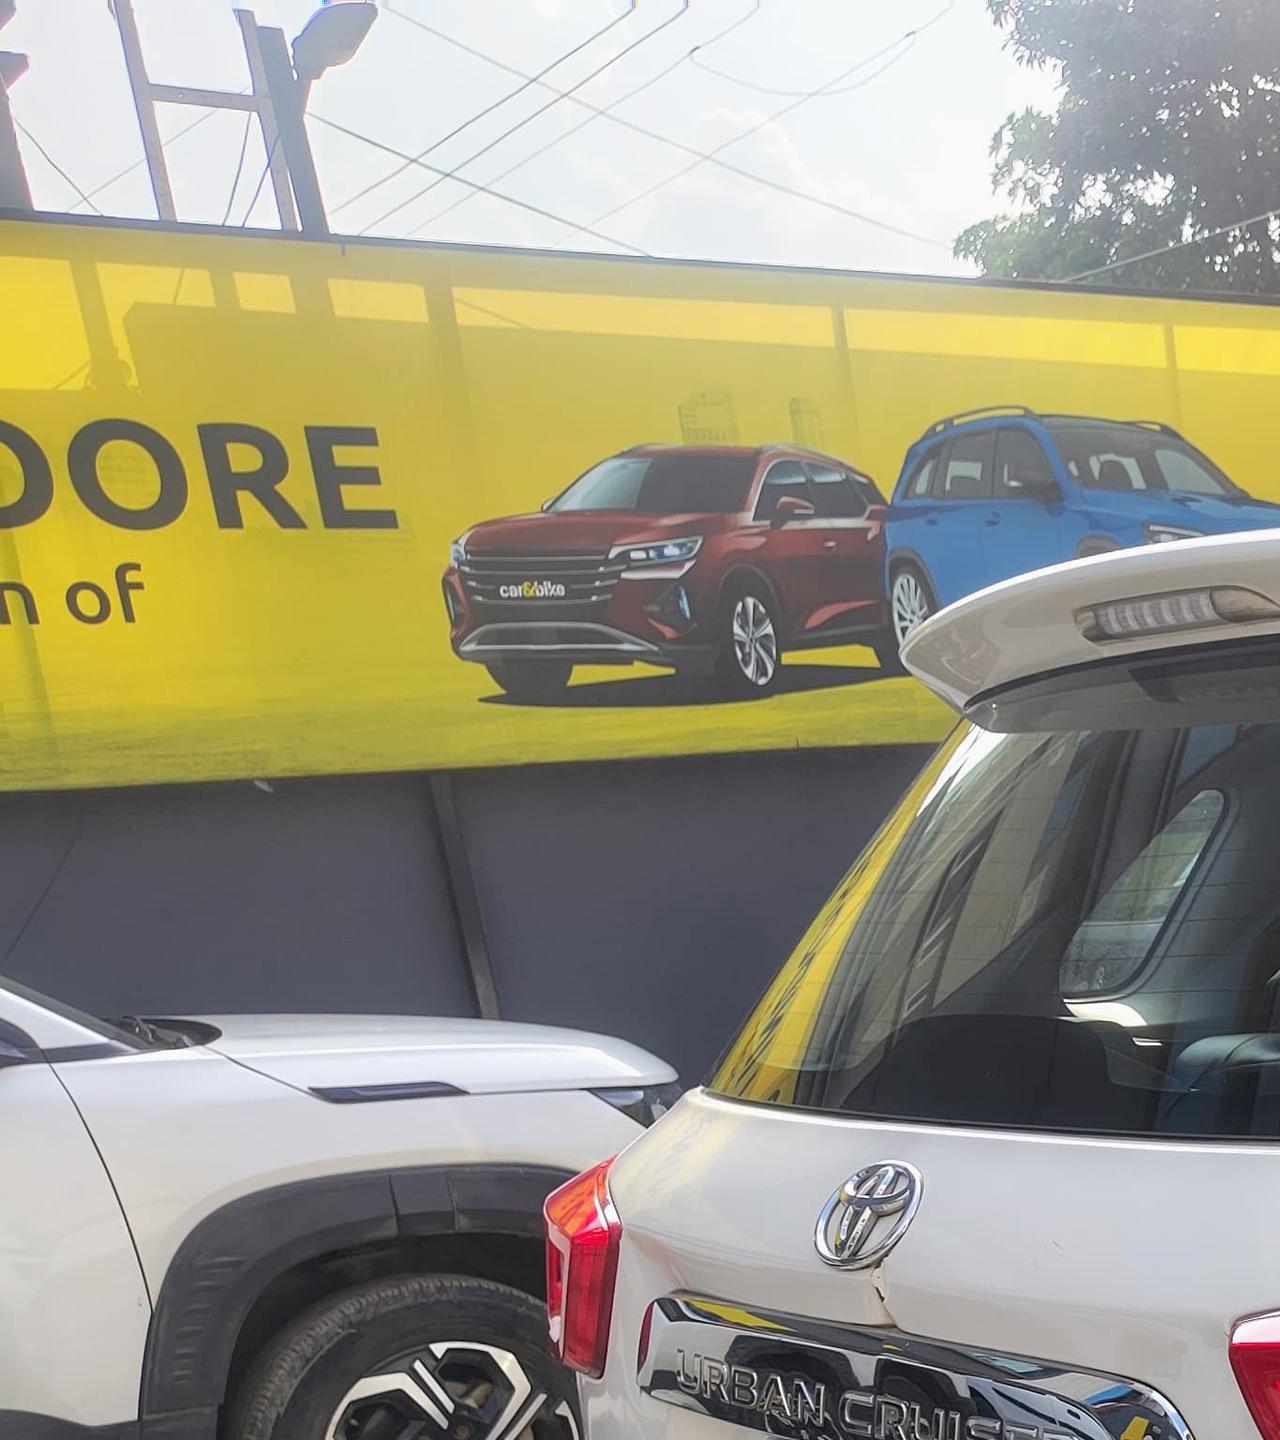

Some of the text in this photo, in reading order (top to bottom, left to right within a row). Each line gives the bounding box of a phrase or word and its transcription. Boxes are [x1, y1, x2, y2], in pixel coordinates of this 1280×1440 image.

[66, 562, 144, 625] of
[500, 579, 566, 598] car&bike
[676, 1348, 826, 1429] URBAN
